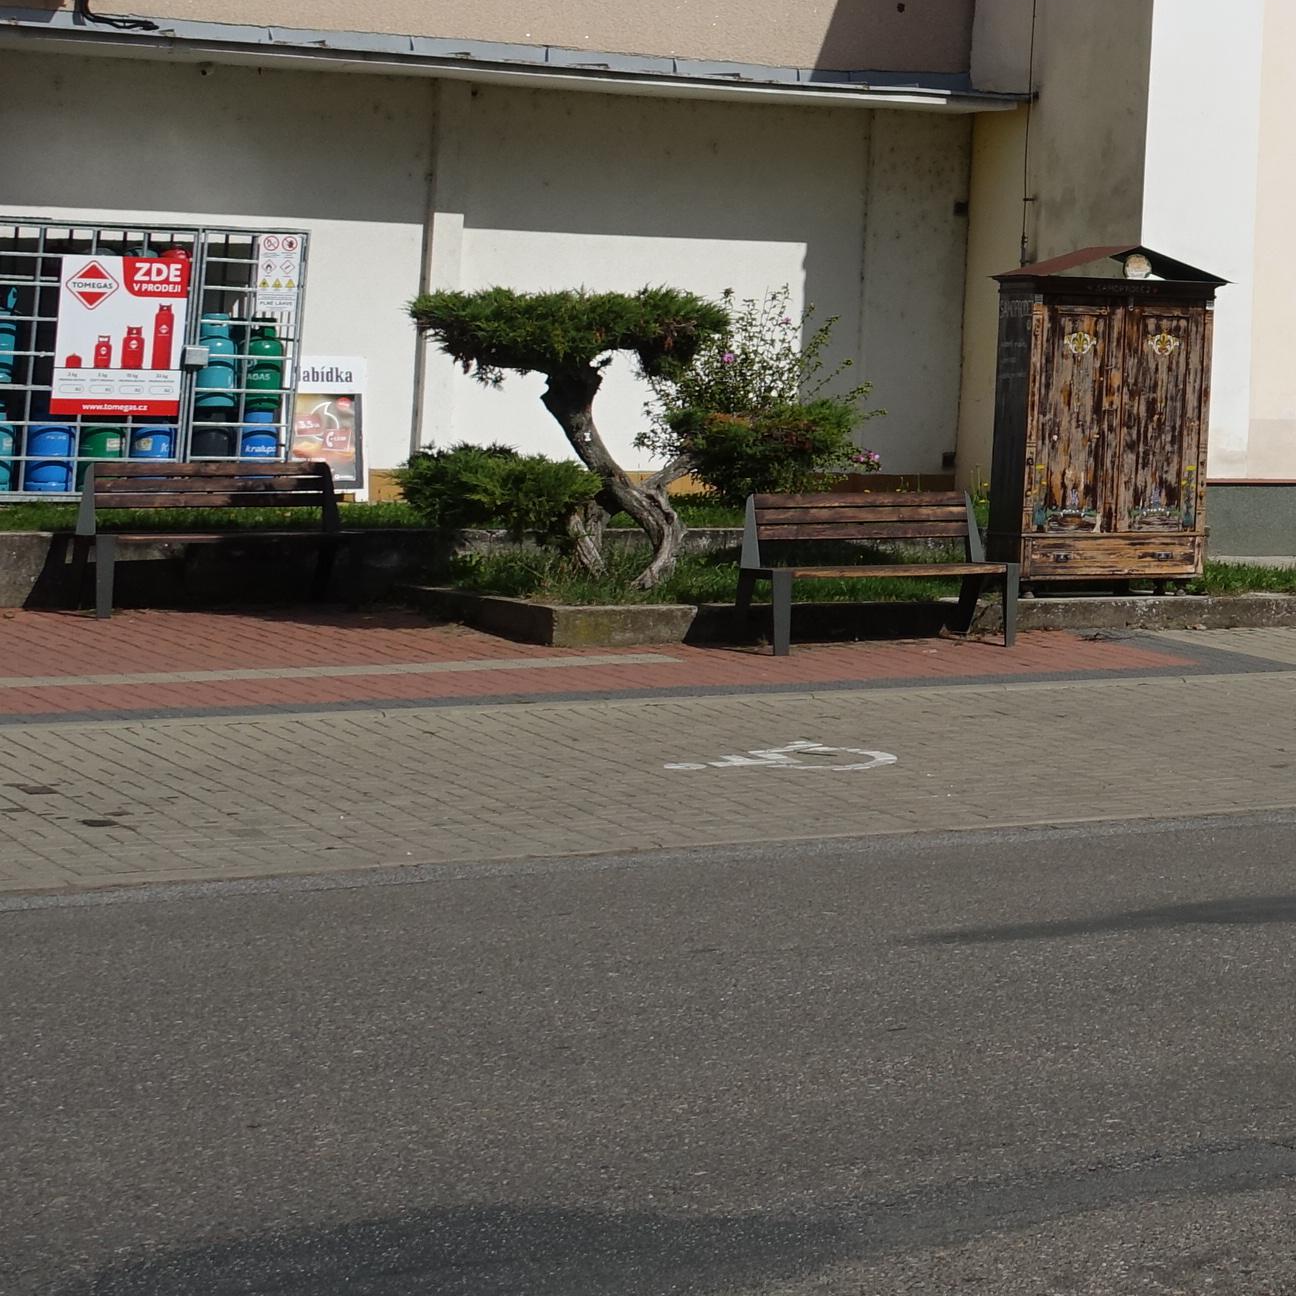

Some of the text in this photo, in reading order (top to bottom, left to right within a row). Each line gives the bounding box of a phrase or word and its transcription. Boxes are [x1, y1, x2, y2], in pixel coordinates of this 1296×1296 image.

[133, 262, 182, 282] ZDE
[72, 281, 113, 290] TOMEGAS
[133, 283, 181, 293] V PRODEJI
[299, 366, 353, 383] abídka
[82, 403, 148, 413] www.tomegas.cz
